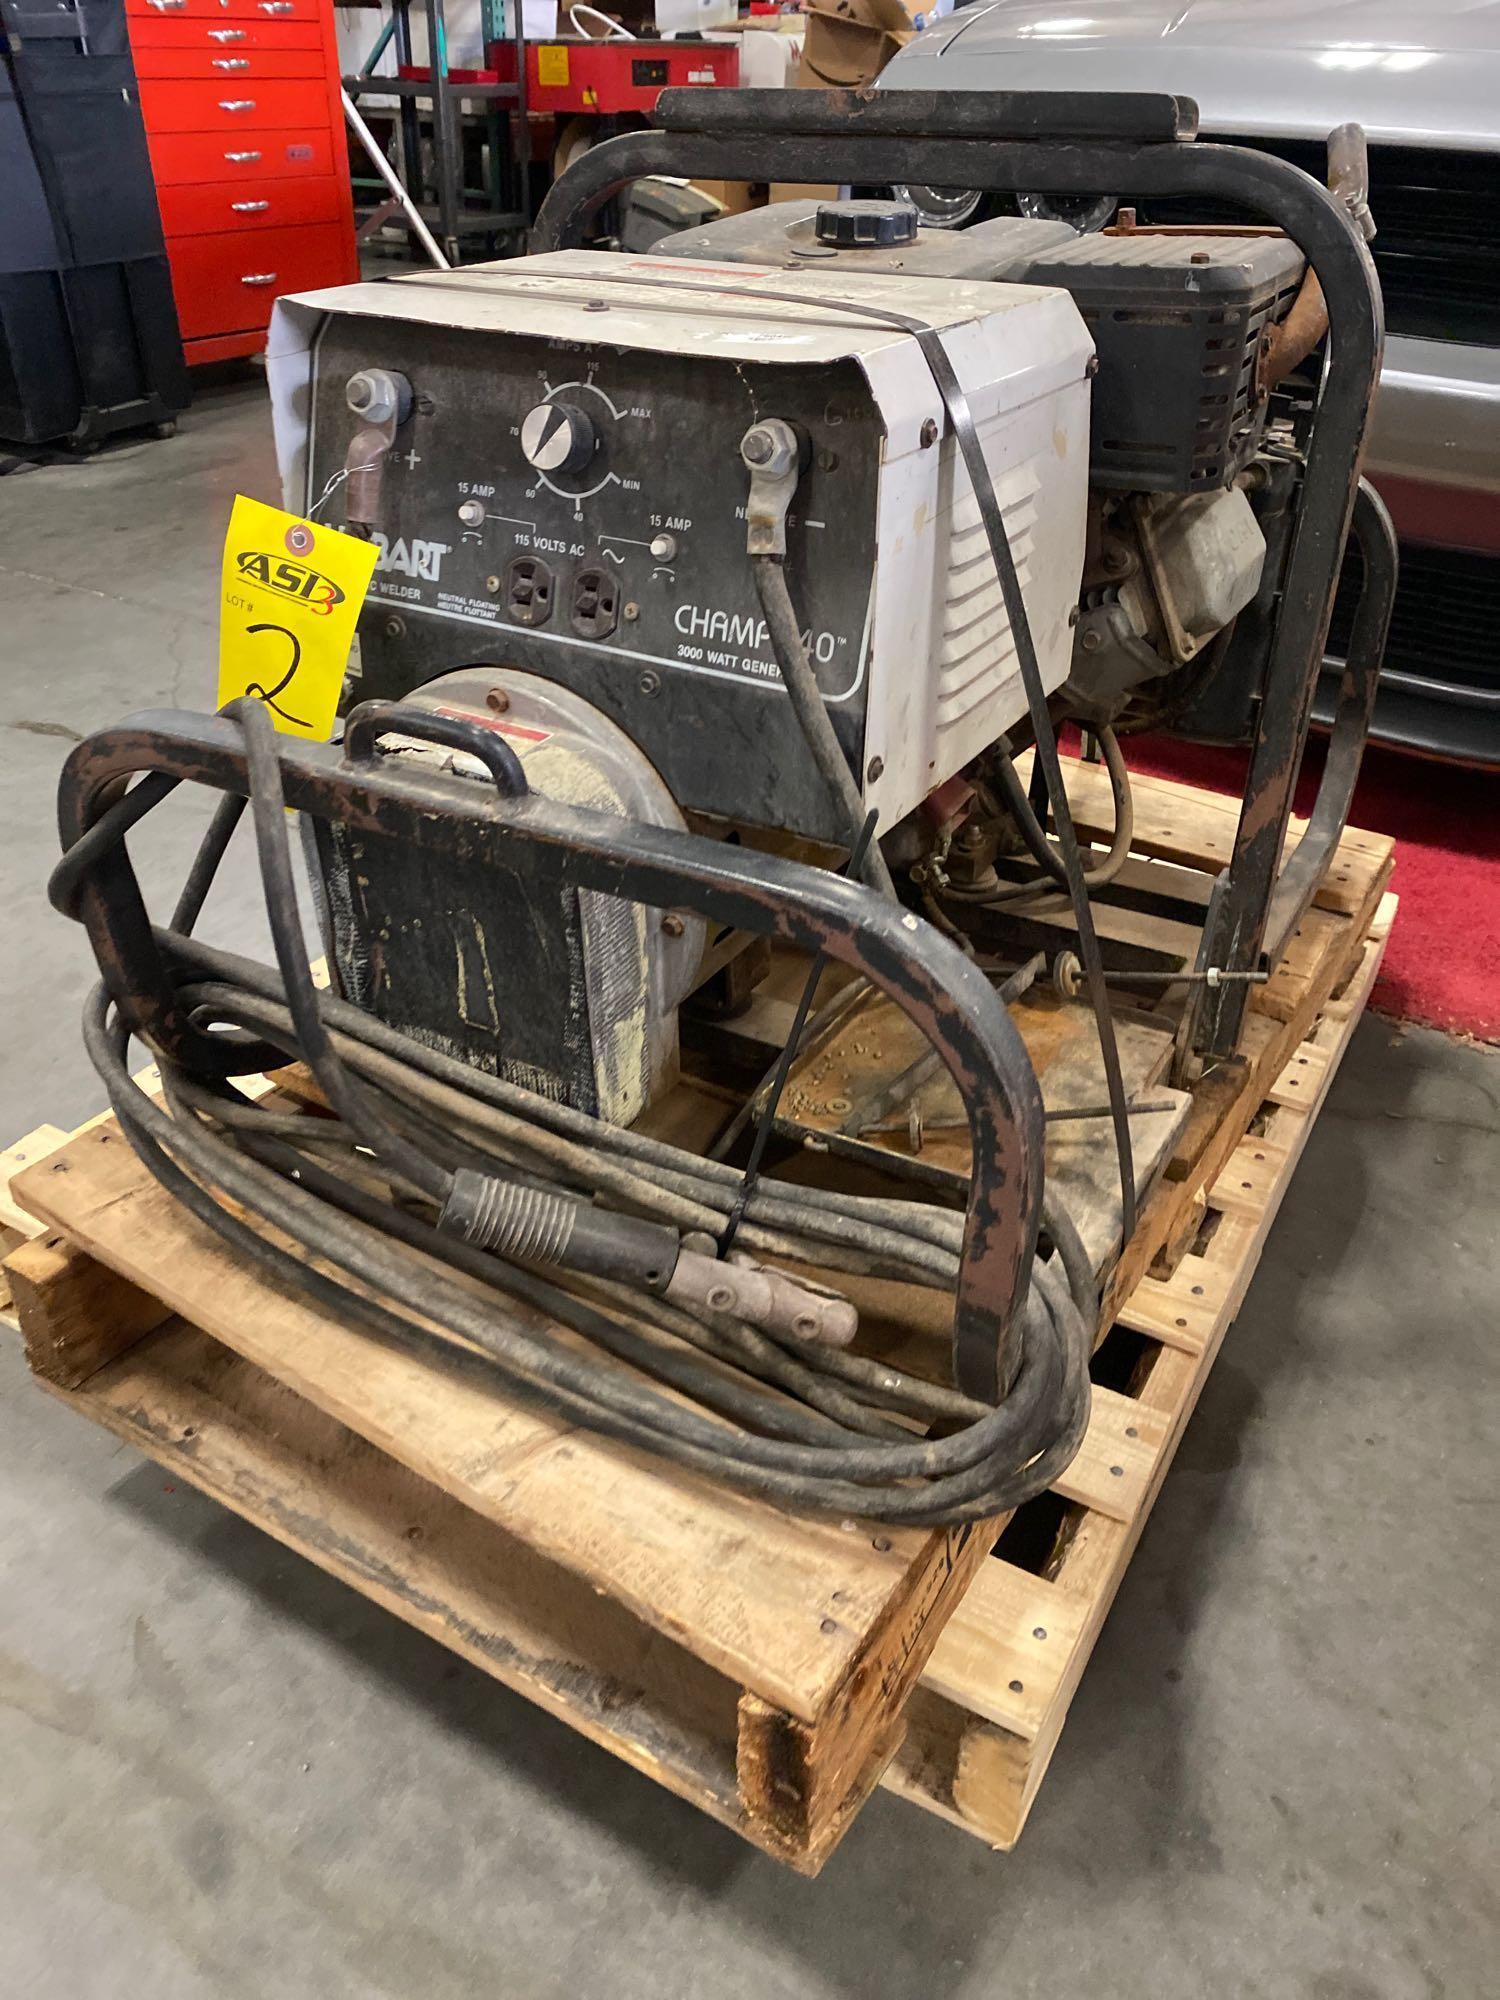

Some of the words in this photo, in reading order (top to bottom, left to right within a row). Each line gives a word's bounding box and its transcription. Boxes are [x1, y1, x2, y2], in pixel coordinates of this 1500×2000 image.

[586, 361, 600, 372] 115
[631, 407, 652, 419] MAX
[510, 426, 520, 437] 70
[457, 481, 469, 494] 15
[471, 483, 496, 498] AMP
[622, 479, 641, 491] MIN
[573, 512, 584, 522] 40
[649, 514, 661, 527] 15
[665, 516, 692, 532] AMP
[514, 533, 530, 547] 115
[532, 536, 566, 554] VOLTS
[569, 543, 586, 557] AC
[380, 581, 421, 600] WELDER
[226, 591, 247, 607] LOT
[437, 592, 467, 605] NEUTRAL
[468, 598, 501, 612] FLOATING
[464, 606, 497, 620] FLOTTANT
[677, 643, 703, 660] 3000
[707, 649, 739, 668] WATT
[244, 623, 315, 729] 2
